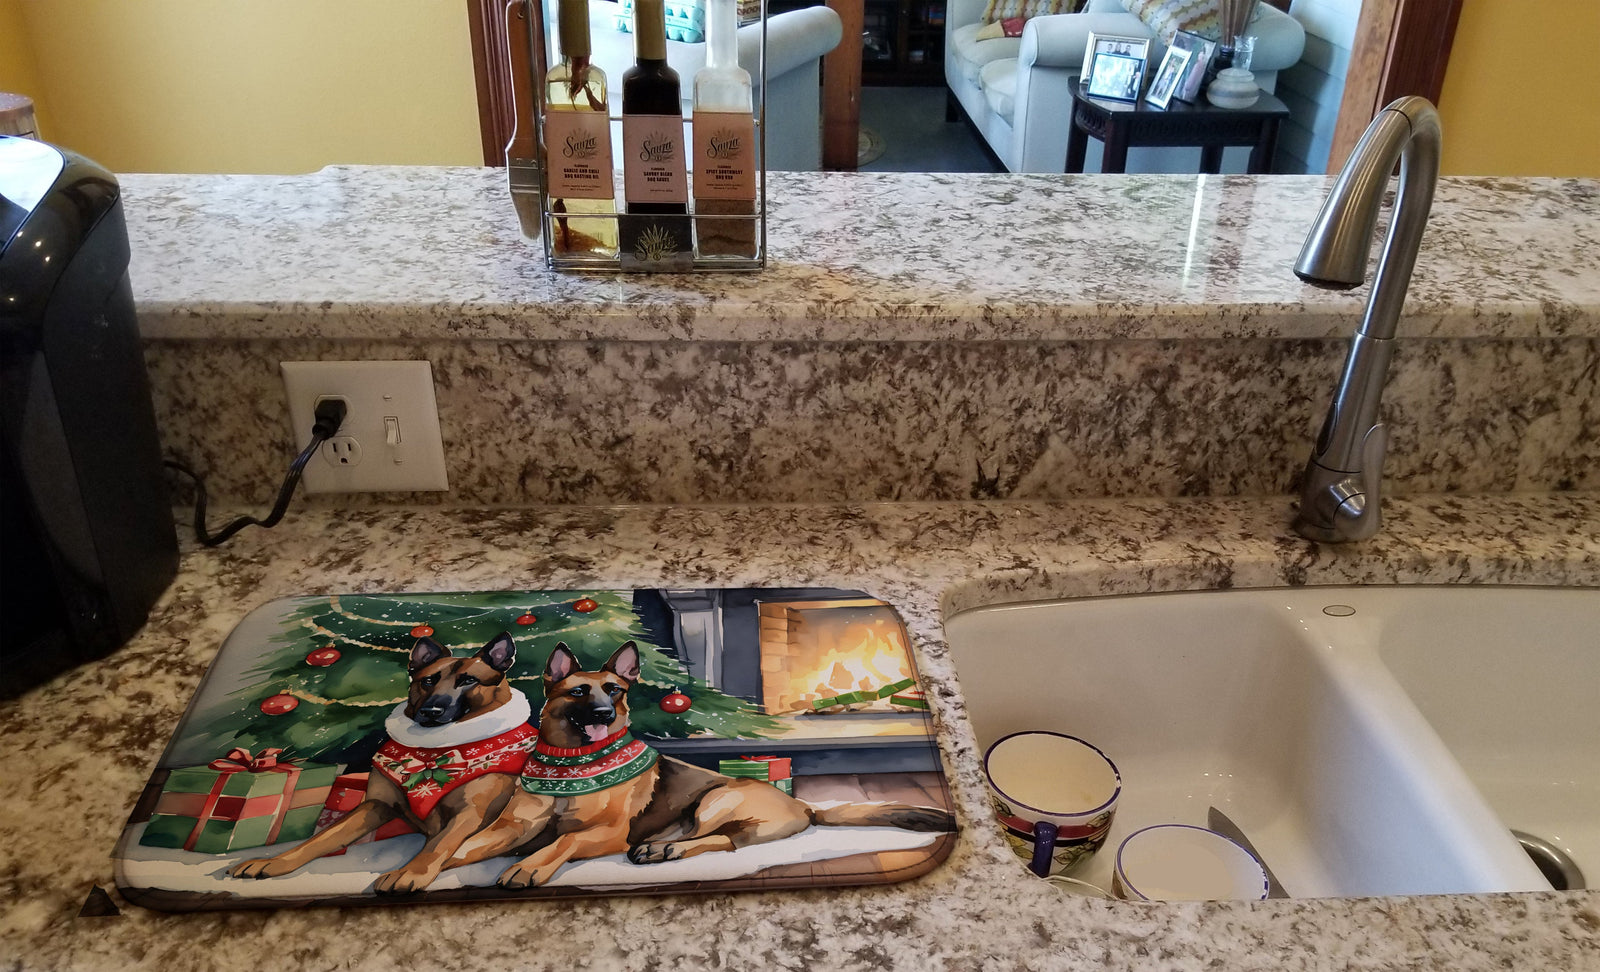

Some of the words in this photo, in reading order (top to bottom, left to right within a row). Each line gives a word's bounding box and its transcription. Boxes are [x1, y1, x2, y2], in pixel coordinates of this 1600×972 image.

[563, 136, 597, 158] Sauza
[640, 140, 673, 162] Sauza
[707, 137, 740, 159] Sauza
